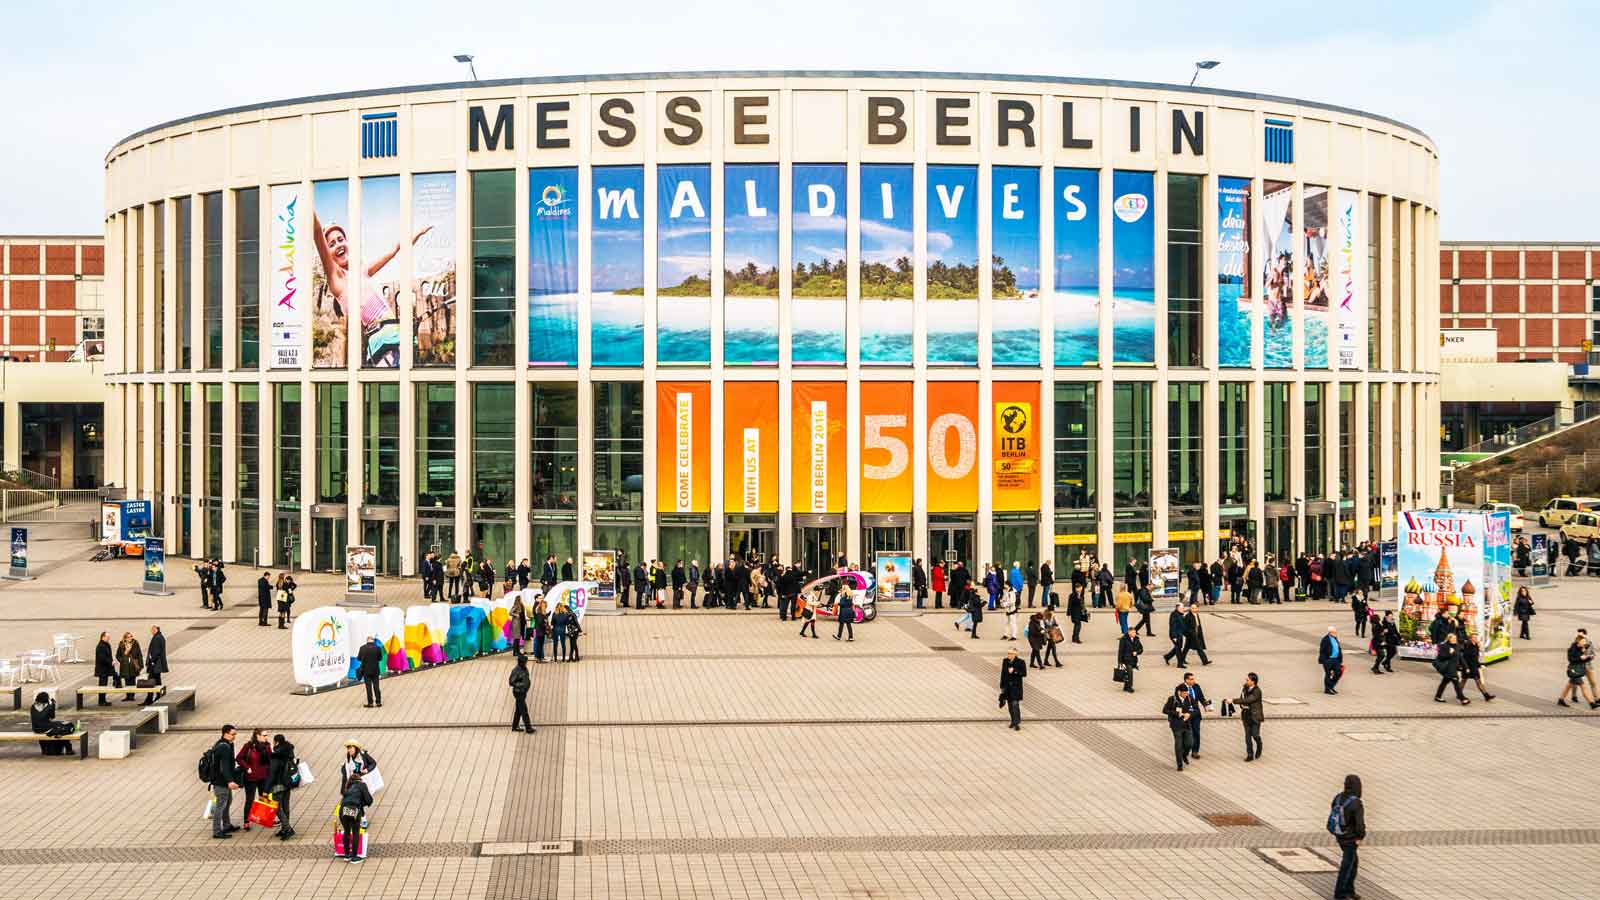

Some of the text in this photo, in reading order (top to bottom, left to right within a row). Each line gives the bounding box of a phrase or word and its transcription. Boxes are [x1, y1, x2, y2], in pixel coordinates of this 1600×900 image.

[469, 96, 1204, 156] MESSE BERLIN
[536, 205, 571, 216] Maldives
[278, 195, 298, 312] Andalucía
[680, 399, 689, 508] COME CELEBRATE
[1002, 438, 1025, 450] ITB
[815, 409, 824, 509] ITB BERLIN 2016
[1001, 462, 1011, 471] 50
[746, 438, 757, 508] WITH US AT
[1403, 512, 1466, 532] VISIT
[1408, 532, 1475, 548] RUSSIA
[310, 654, 345, 669] Maldives
